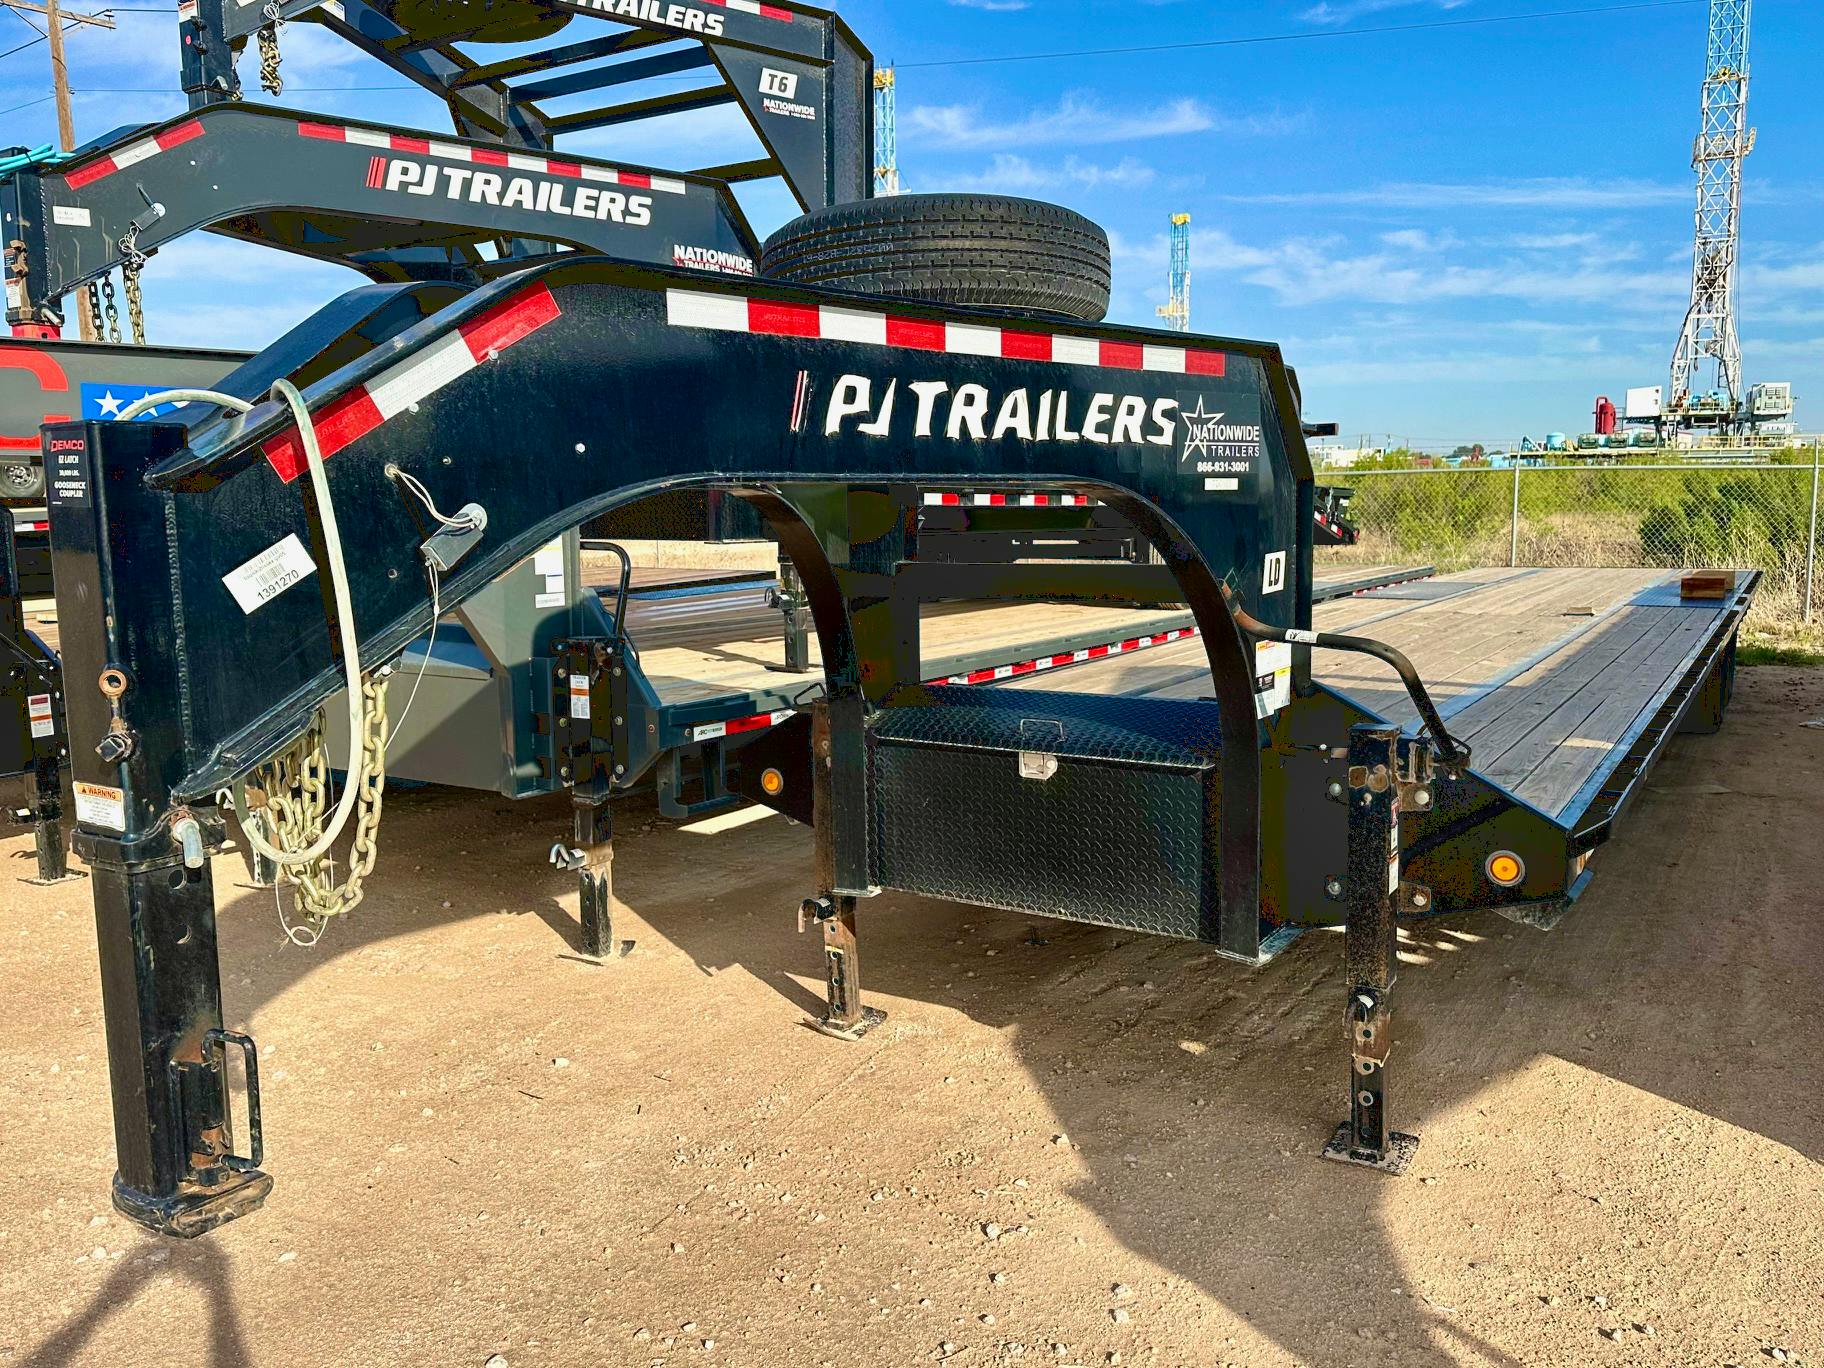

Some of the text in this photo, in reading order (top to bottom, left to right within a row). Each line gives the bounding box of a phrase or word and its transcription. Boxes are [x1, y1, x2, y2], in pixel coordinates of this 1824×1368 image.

[768, 73, 788, 93] T6
[763, 97, 816, 116] NATIONWIDE
[385, 159, 653, 227] PJ TRAILERS
[673, 244, 753, 273] NATIONWIDE
[683, 259, 721, 273] TRAILERS
[824, 373, 1180, 446] PJ TRAILERS
[1192, 424, 1260, 441] NATIONWIDE
[50, 440, 84, 452] DEMCO
[1211, 445, 1260, 457] TRAILERS
[1197, 461, 1249, 473] 866-931-3001
[54, 481, 86, 490] GOOSENECK
[60, 490, 83, 498] COUPLER
[1268, 557, 1281, 588] LD
[257, 569, 300, 601] 1391270
[88, 786, 116, 800] WARNING
